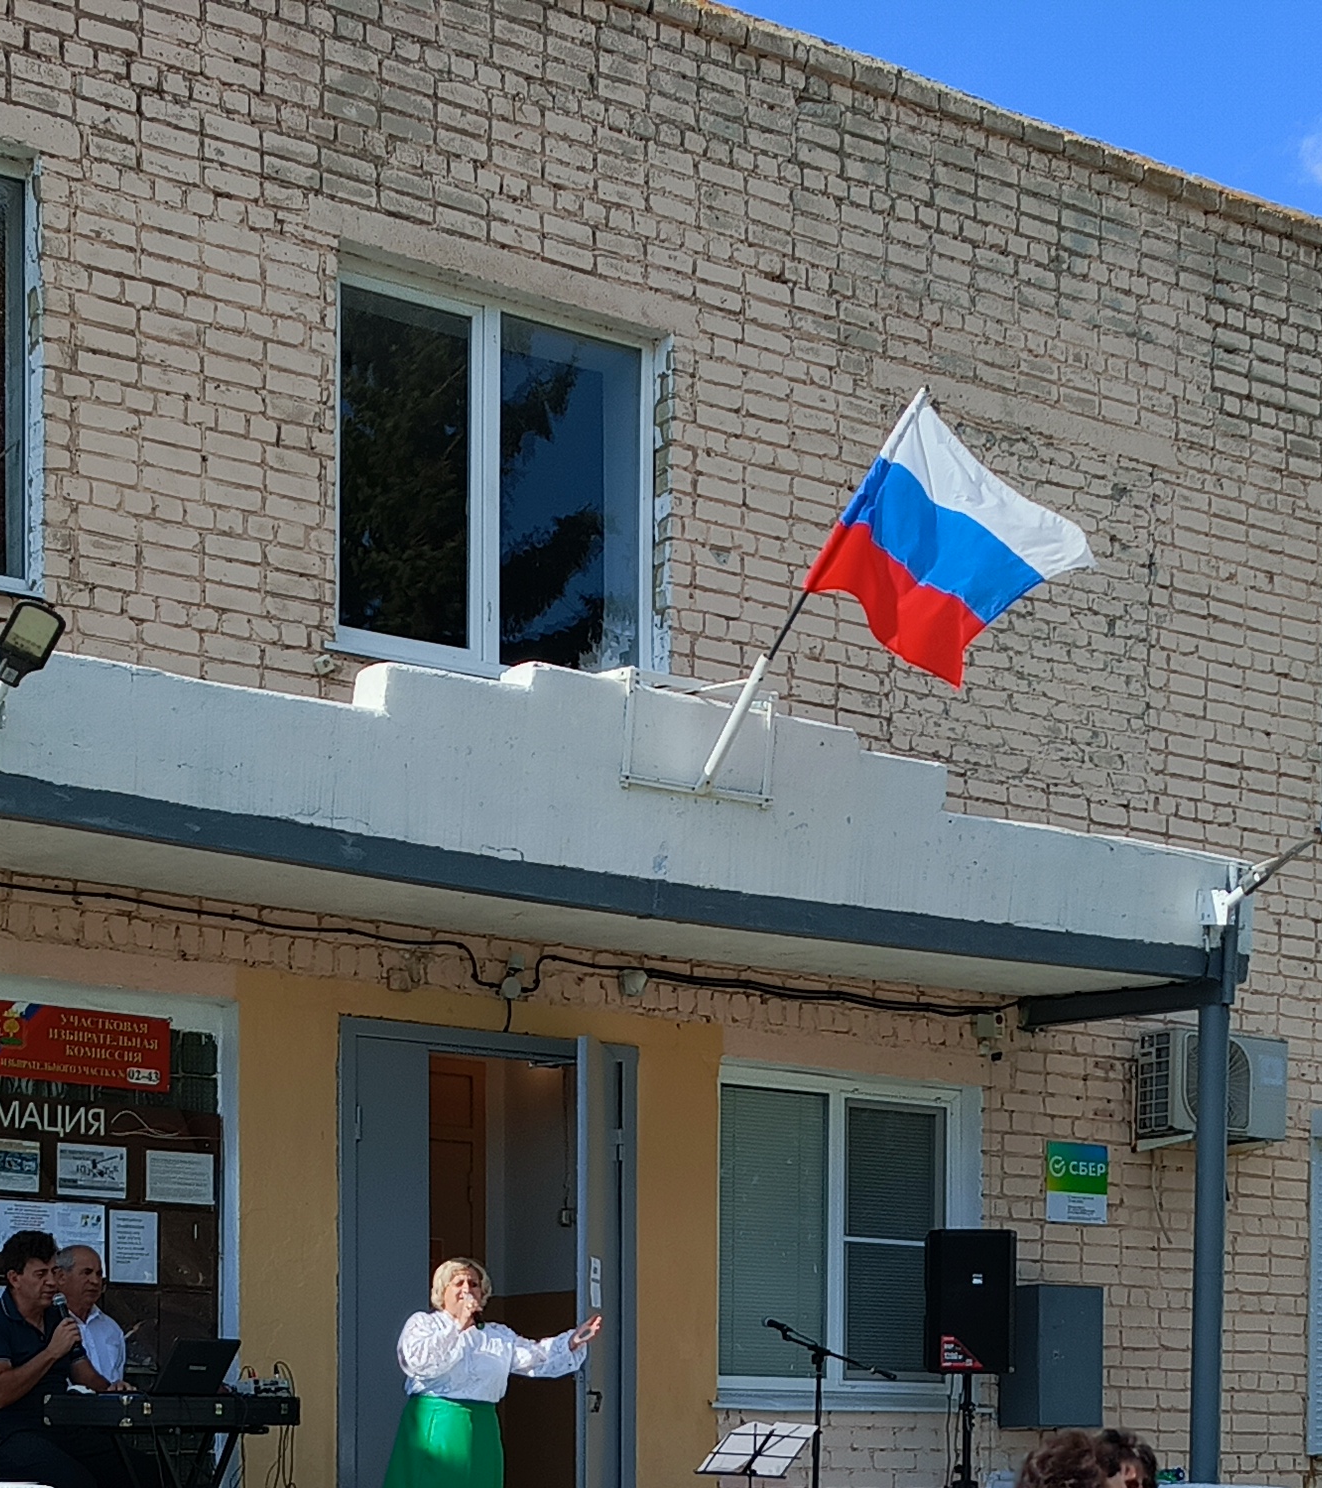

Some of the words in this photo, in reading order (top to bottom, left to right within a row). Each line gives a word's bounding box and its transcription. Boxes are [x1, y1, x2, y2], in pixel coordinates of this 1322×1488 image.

[60, 1013, 148, 1034] УЧАСТКОВАЯ
[49, 1028, 158, 1050] ИЗБИРАТЕЛЬНАЯ
[65, 1044, 142, 1063] КОМИССИЯ
[1069, 1161, 1106, 1177] СБЕР
